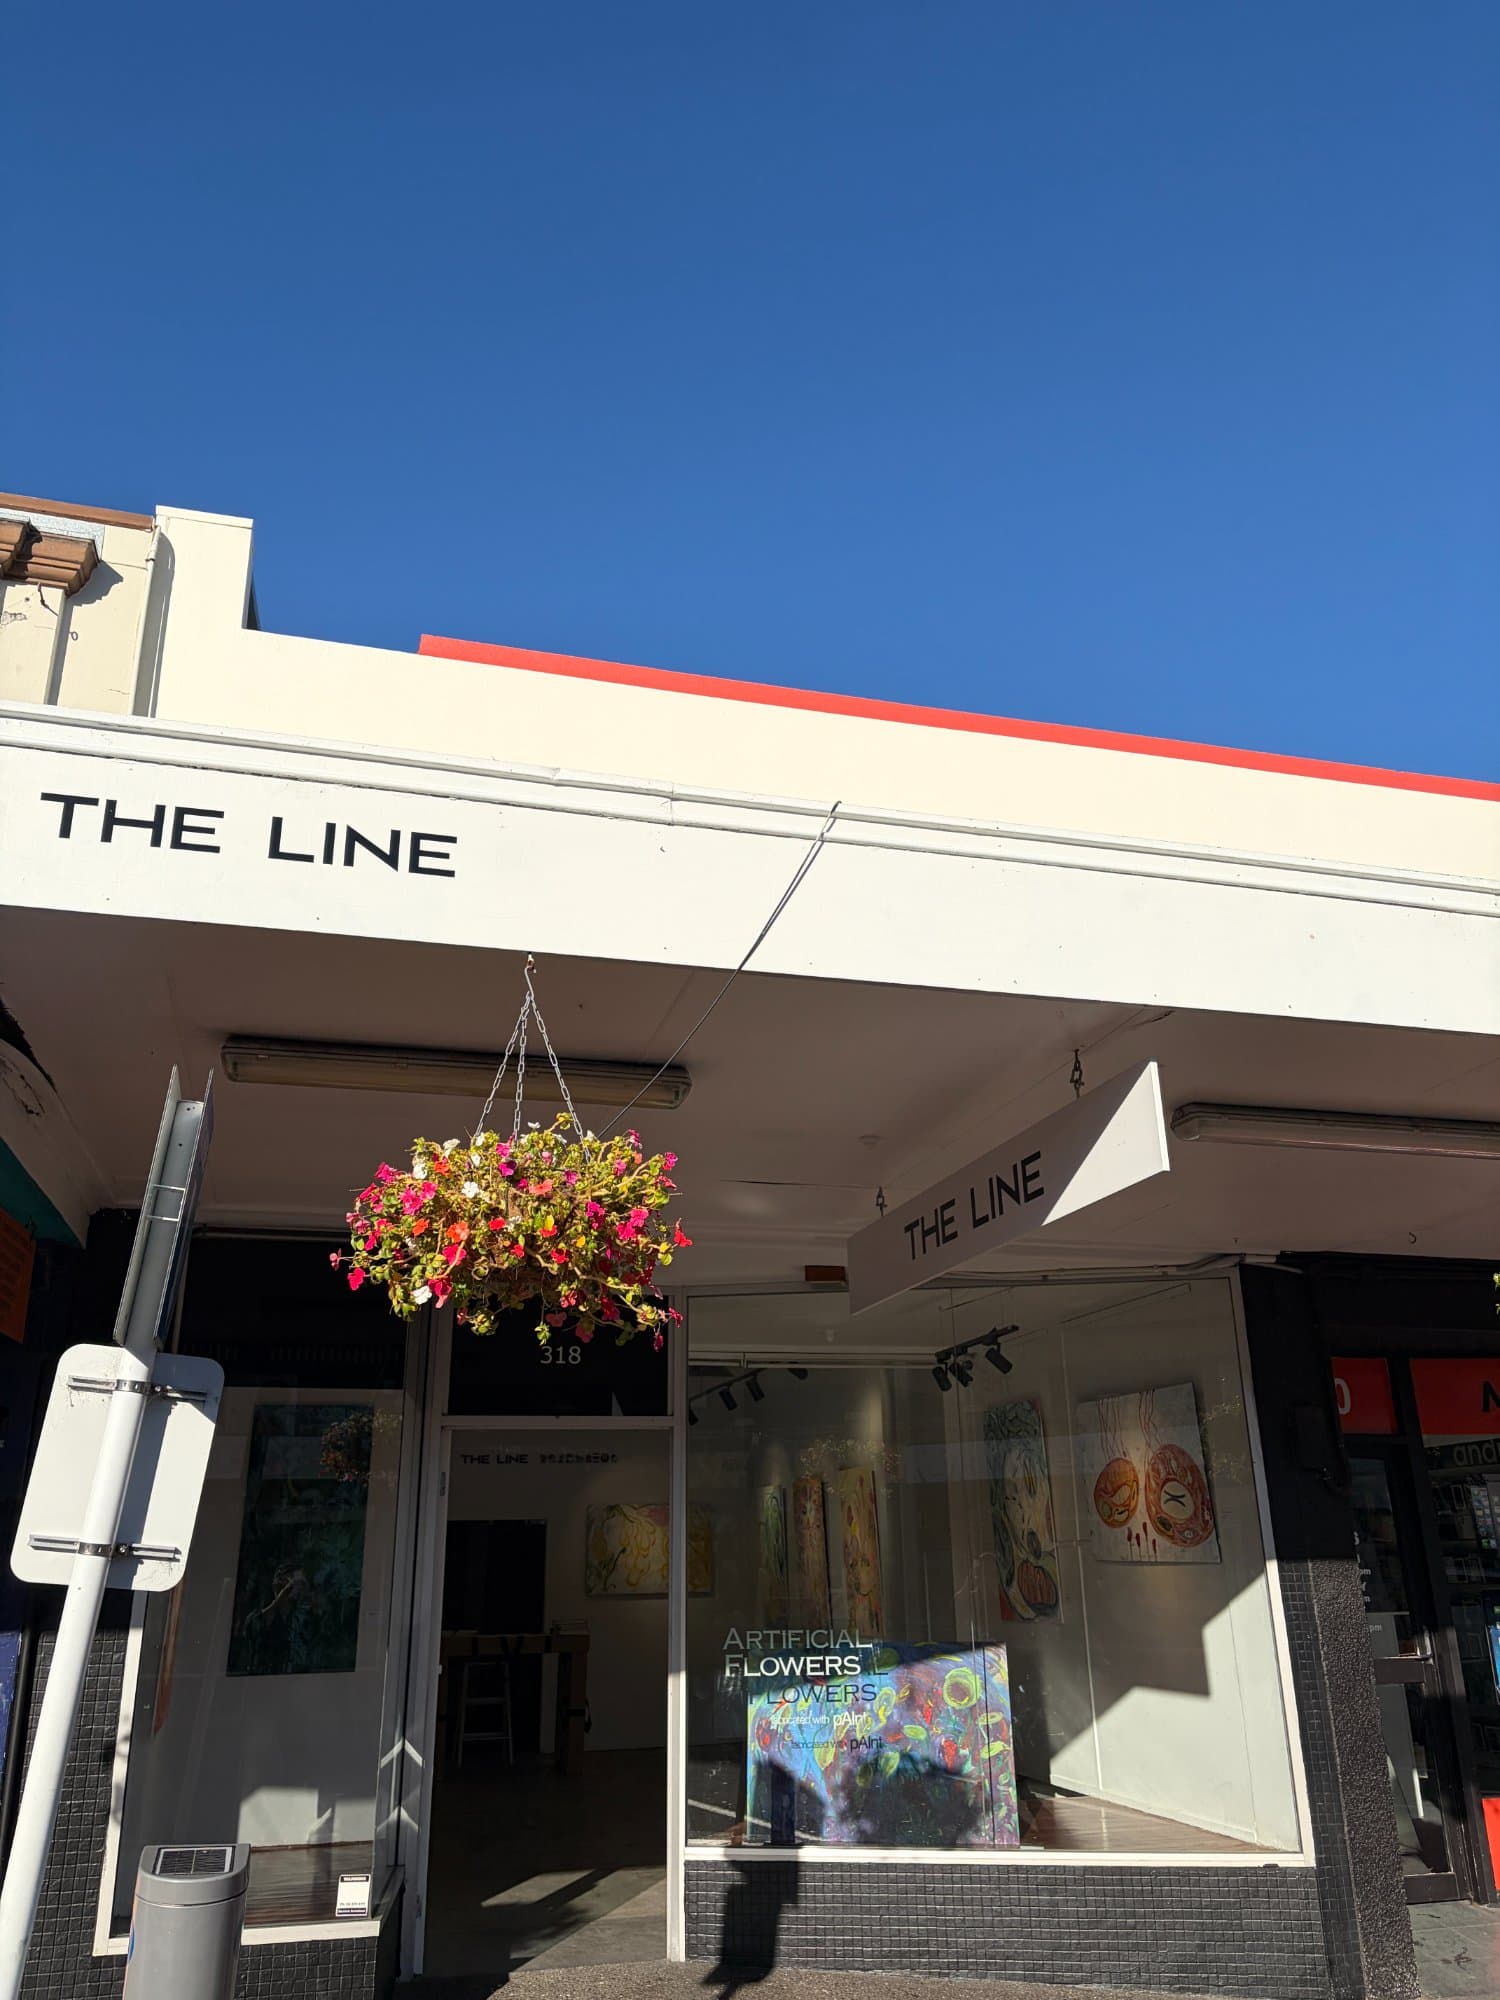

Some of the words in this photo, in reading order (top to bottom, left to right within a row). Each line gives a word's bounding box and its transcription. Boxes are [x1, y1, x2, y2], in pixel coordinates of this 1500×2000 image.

[40, 792, 225, 855] THE
[267, 816, 458, 878] LINE
[904, 1198, 958, 1261] THE
[969, 1150, 1045, 1229] LINE
[539, 1346, 582, 1366] 318
[460, 1454, 490, 1465] THE
[496, 1454, 529, 1465] LINE
[1453, 1439, 1500, 1466] and
[722, 1627, 873, 1650] ARTIFICIAL
[725, 1654, 861, 1677] FLOWERS
